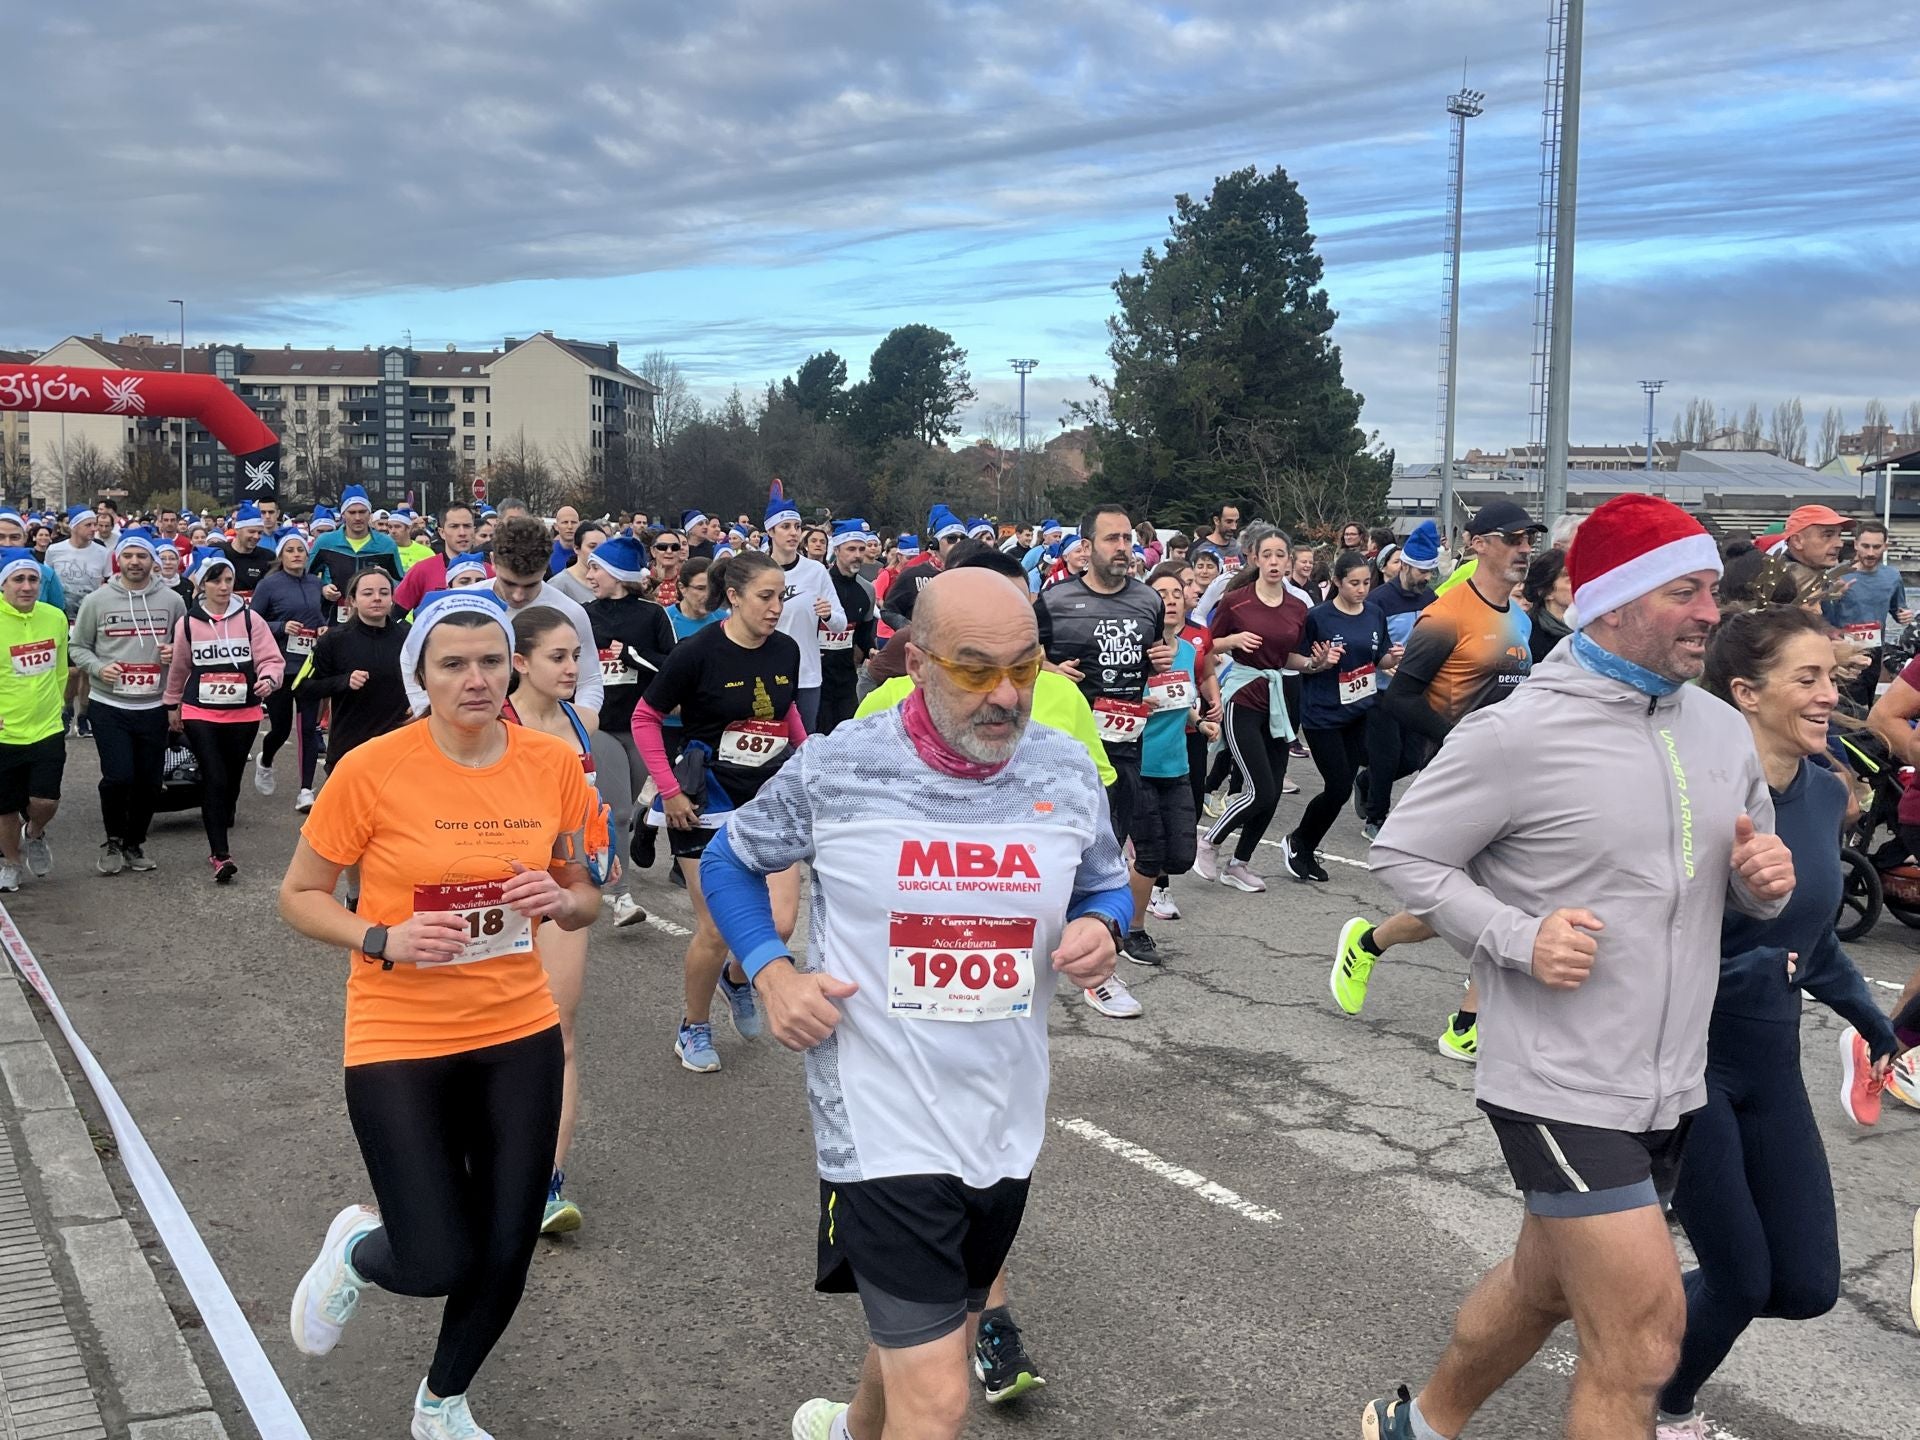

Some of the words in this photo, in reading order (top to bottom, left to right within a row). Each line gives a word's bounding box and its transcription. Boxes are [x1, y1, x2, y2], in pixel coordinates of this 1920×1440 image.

[1093, 619, 1120, 640] 45
[825, 632, 849, 642] 1747
[193, 644, 250, 660] adidas
[1097, 638, 1133, 652] VILLA
[20, 651, 51, 668] 1120
[1098, 650, 1143, 666] GIJÓN
[602, 661, 628, 675] 723
[121, 674, 155, 686] 1934
[1348, 676, 1369, 693] 308
[209, 684, 237, 695] 726
[1166, 683, 1185, 698] 53
[1103, 714, 1136, 732] 792
[736, 734, 775, 754] 687
[1659, 729, 1688, 791] UNDER
[1679, 792, 1696, 880] ARMOUR
[434, 819, 469, 830] Corre
[473, 820, 499, 830] con
[503, 817, 542, 829] Galbán
[897, 840, 1041, 879] MBA
[440, 886, 451, 895] 37
[898, 880, 953, 892] SURGICAL
[955, 881, 1042, 893] EMPOWERMENT
[475, 891, 485, 899] de
[454, 908, 505, 939] 18
[922, 916, 934, 926] 37
[940, 918, 977, 926] Carrera
[978, 917, 1015, 928] Popular
[963, 928, 974, 937] de
[932, 938, 997, 949] Nochebuena
[906, 951, 1020, 990] 1908
[948, 993, 981, 1001] ENRIQUE
